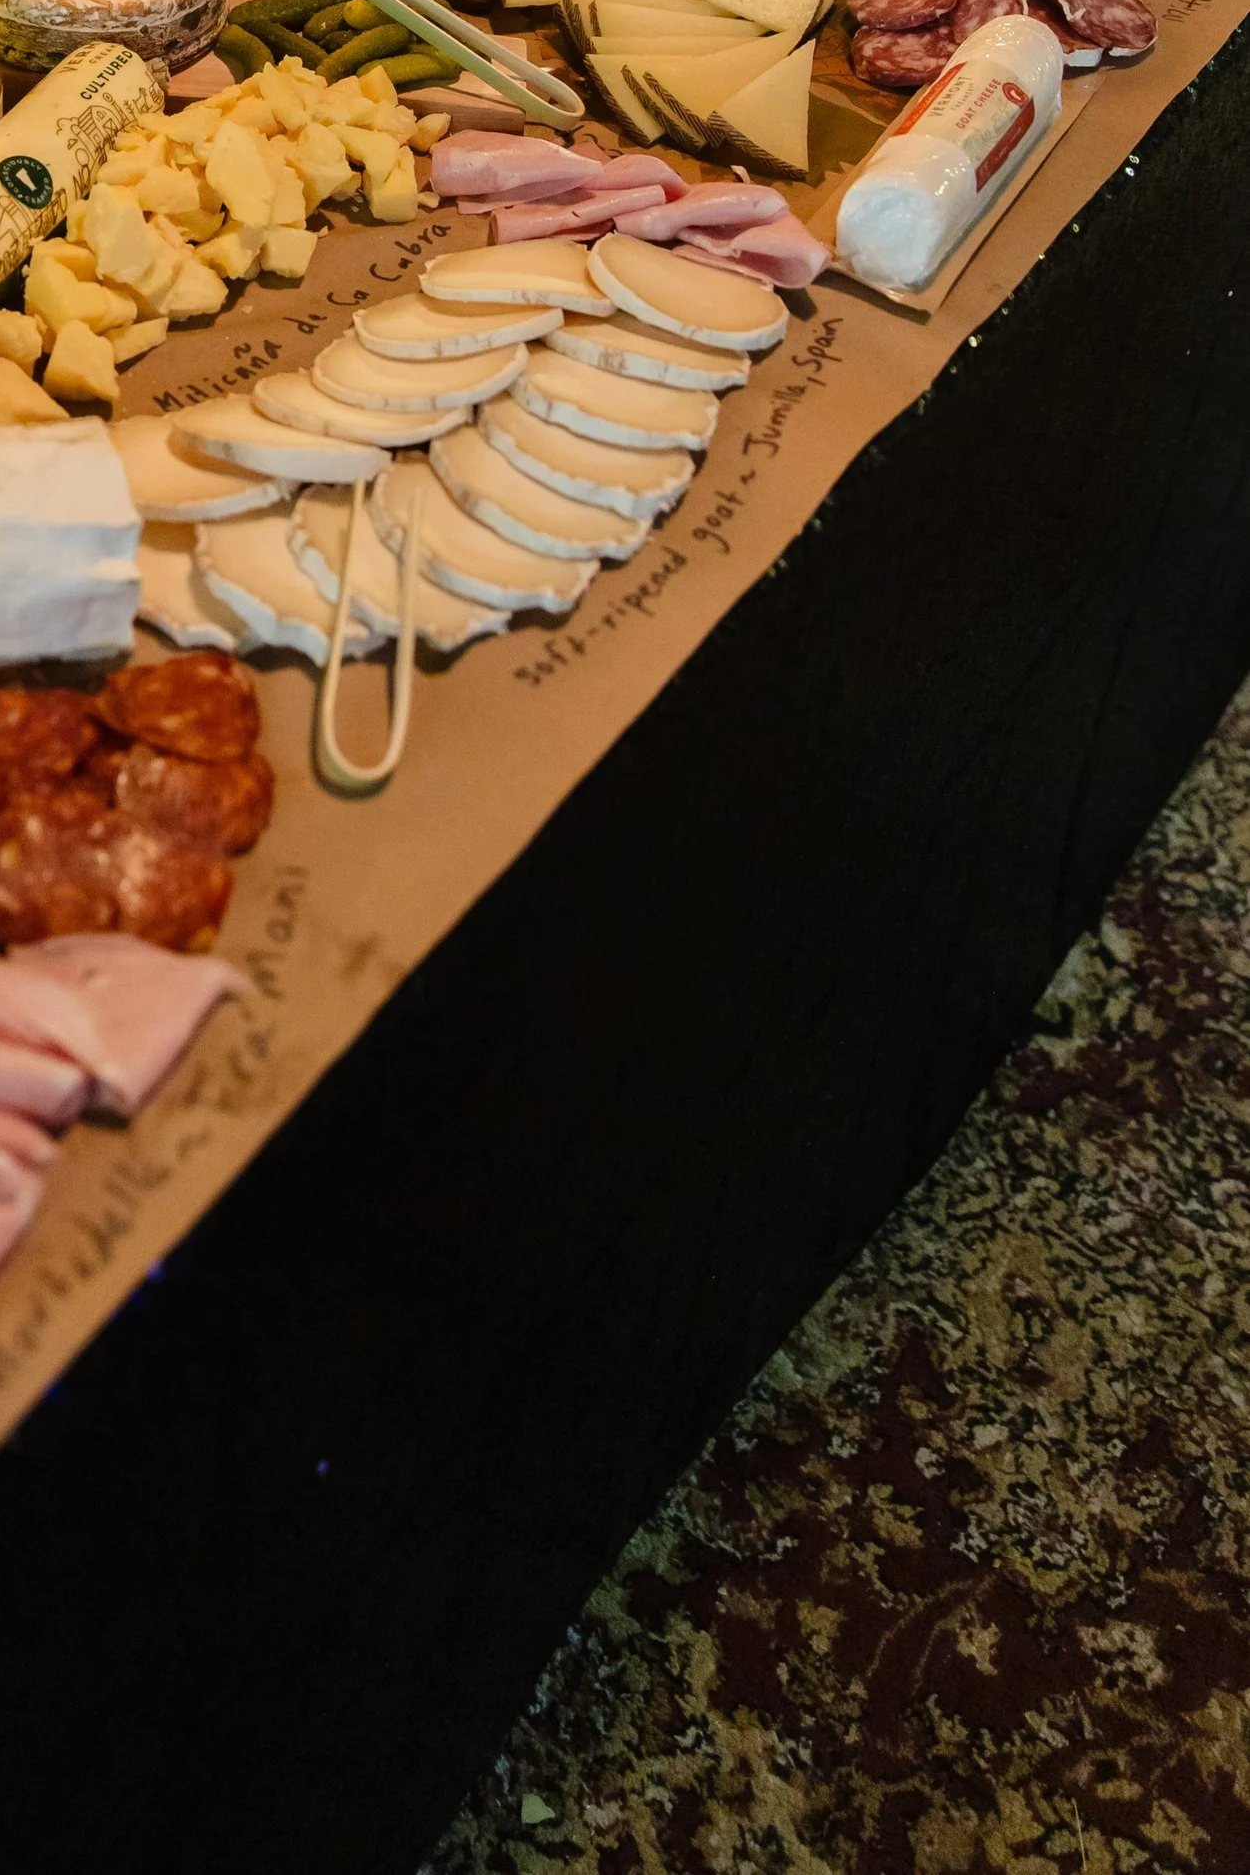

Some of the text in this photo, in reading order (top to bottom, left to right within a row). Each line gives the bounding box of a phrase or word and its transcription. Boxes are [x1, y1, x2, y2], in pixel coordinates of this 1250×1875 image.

[80, 50, 133, 101] CULTURED
[928, 76, 973, 118] VERMONT
[956, 107, 978, 130] GOAT
[973, 78, 1002, 108] CHEESE
[368, 223, 451, 283] Cabra
[693, 489, 745, 554] goat
[792, 316, 844, 375] Spain
